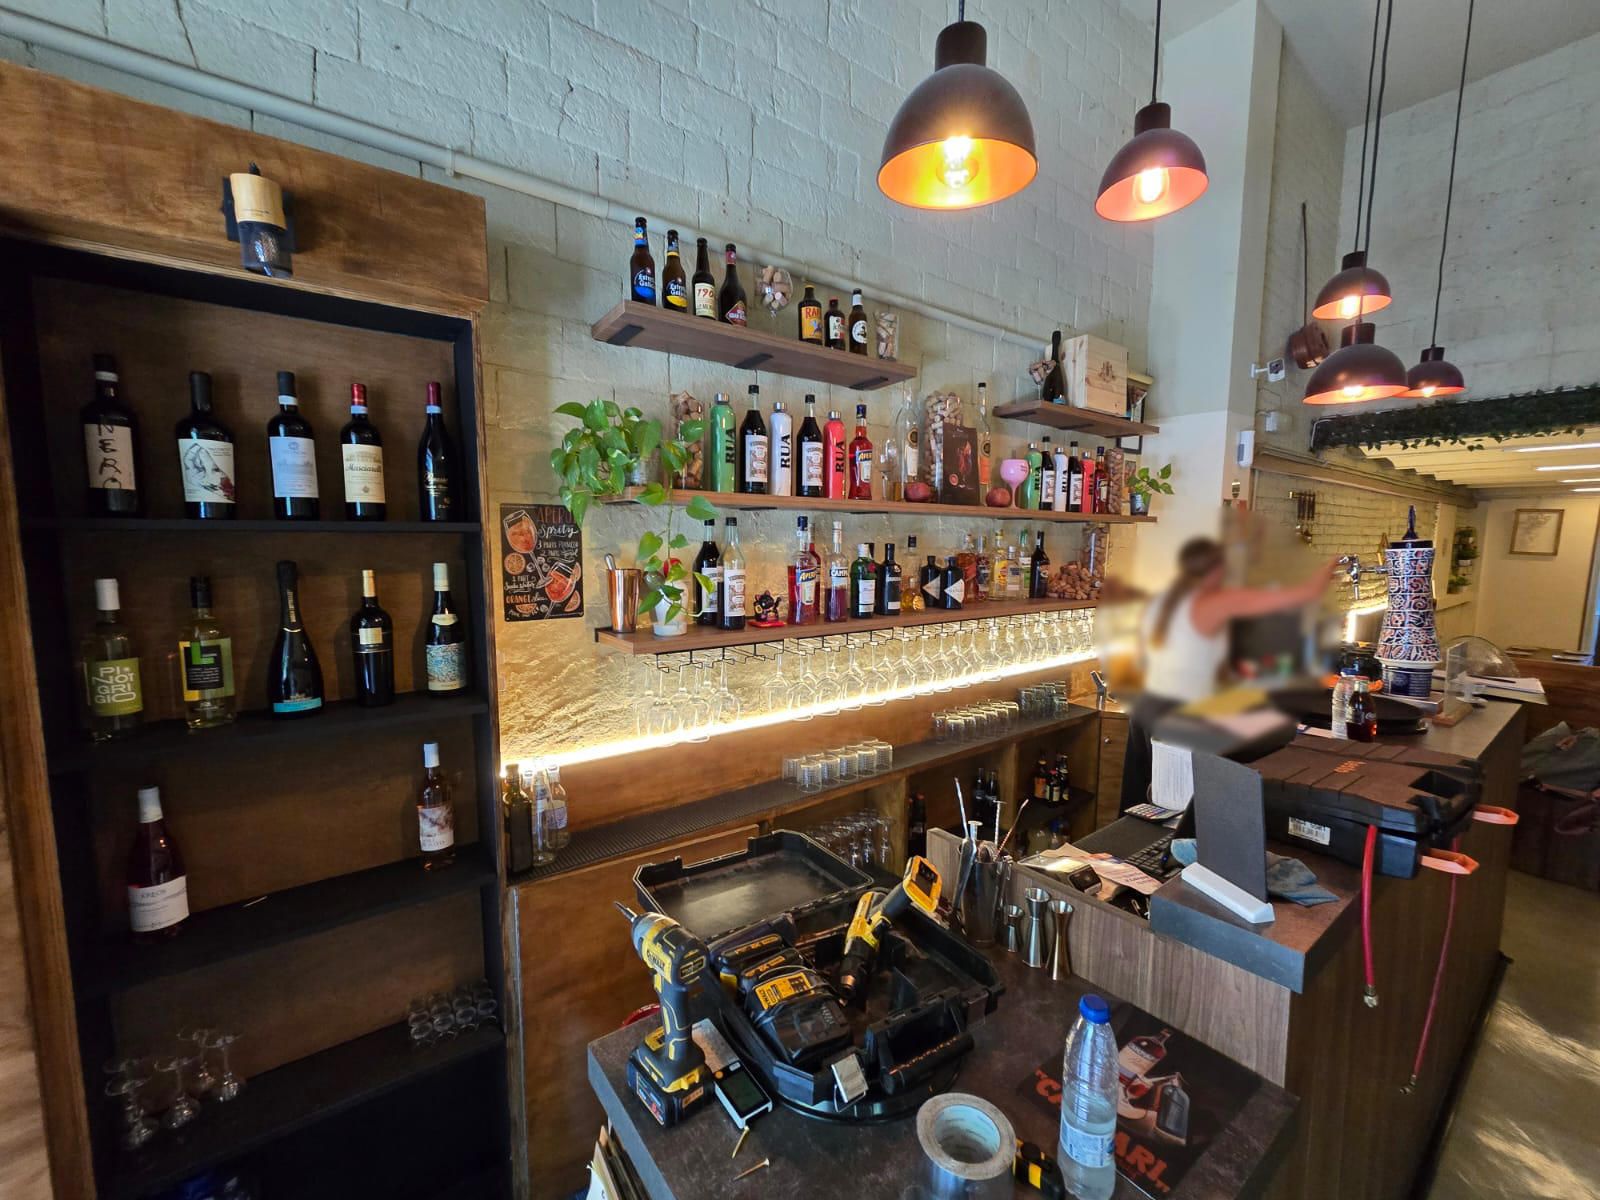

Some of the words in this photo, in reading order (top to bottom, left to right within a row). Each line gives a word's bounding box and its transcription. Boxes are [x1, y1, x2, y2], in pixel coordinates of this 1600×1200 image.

[696, 289, 714, 298] 190
[780, 434, 791, 469] RUA
[835, 441, 845, 473] RUA
